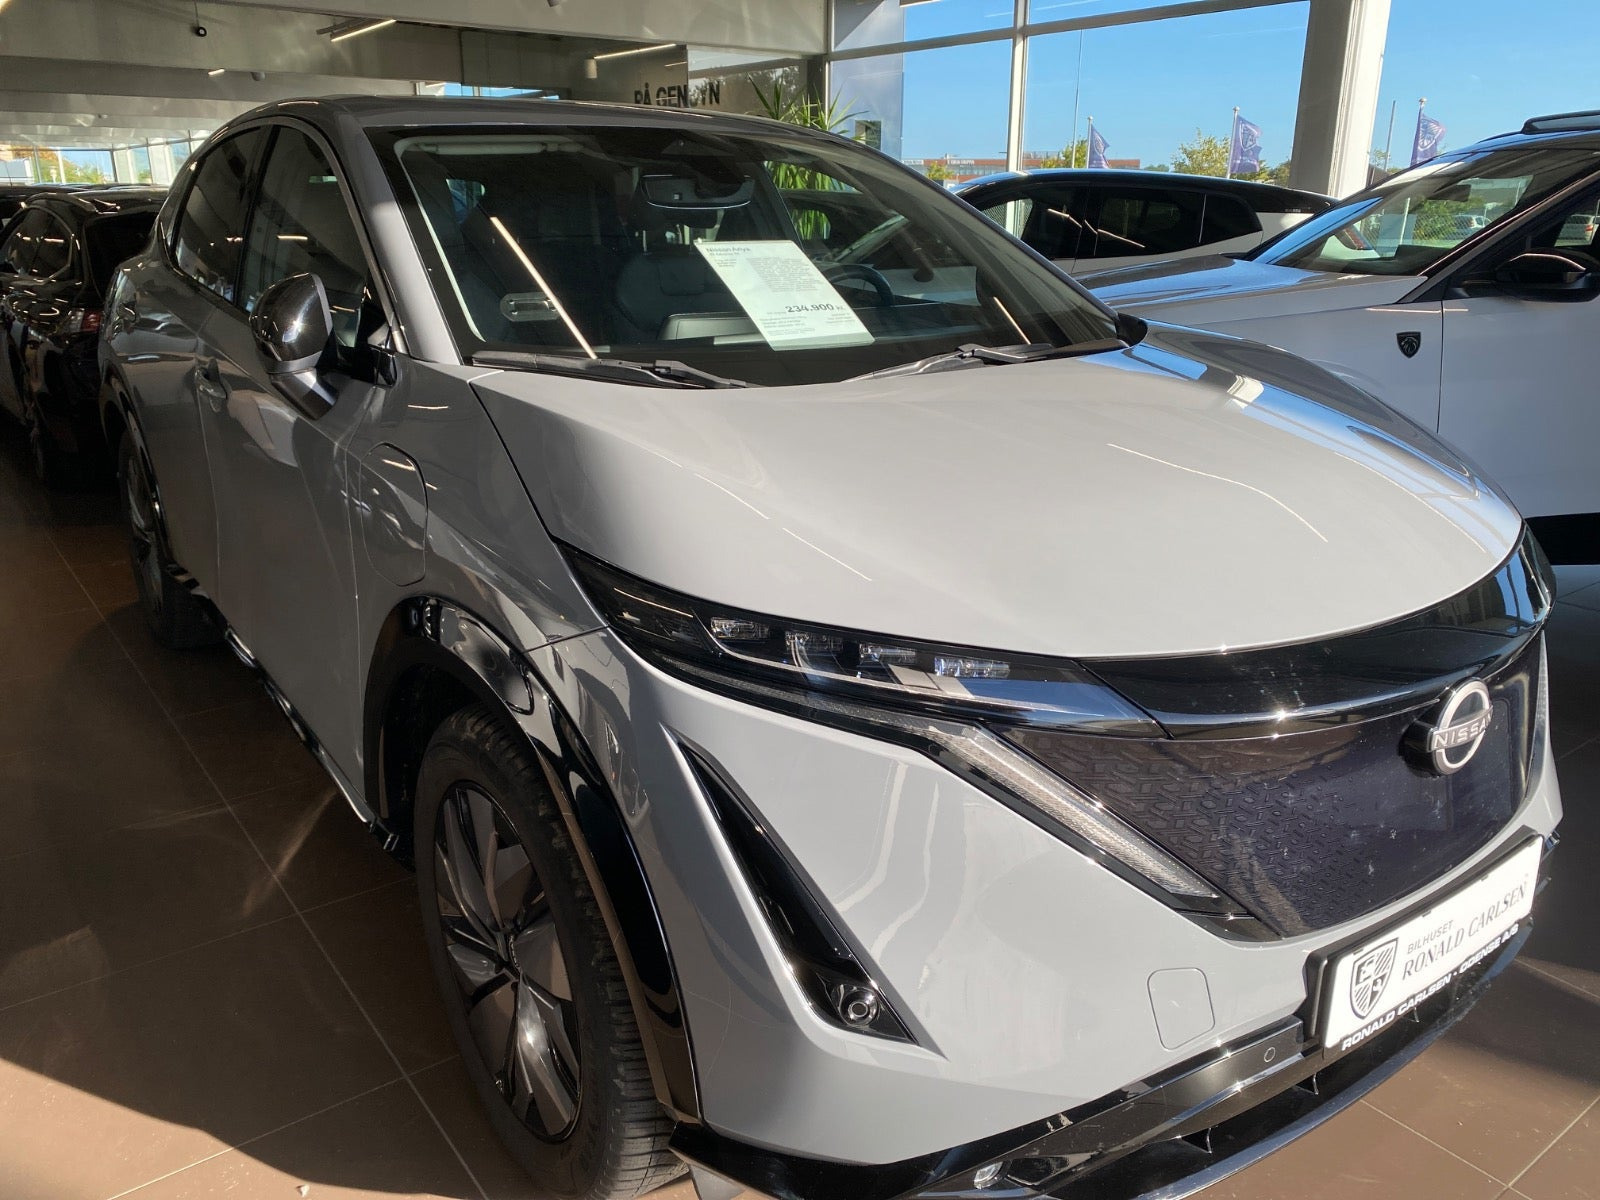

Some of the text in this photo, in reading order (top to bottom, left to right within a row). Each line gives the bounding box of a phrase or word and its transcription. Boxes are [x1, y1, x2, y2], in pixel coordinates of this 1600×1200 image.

[633, 82, 652, 106] PÅ
[785, 303, 834, 313] 234.900
[1433, 713, 1493, 750] NISSAN
[1402, 882, 1526, 981] RONALD CARLSEN
[1407, 919, 1454, 955] BILHUSET
[1341, 922, 1519, 1051] RONALD CARLSEN ODENSE A/S
